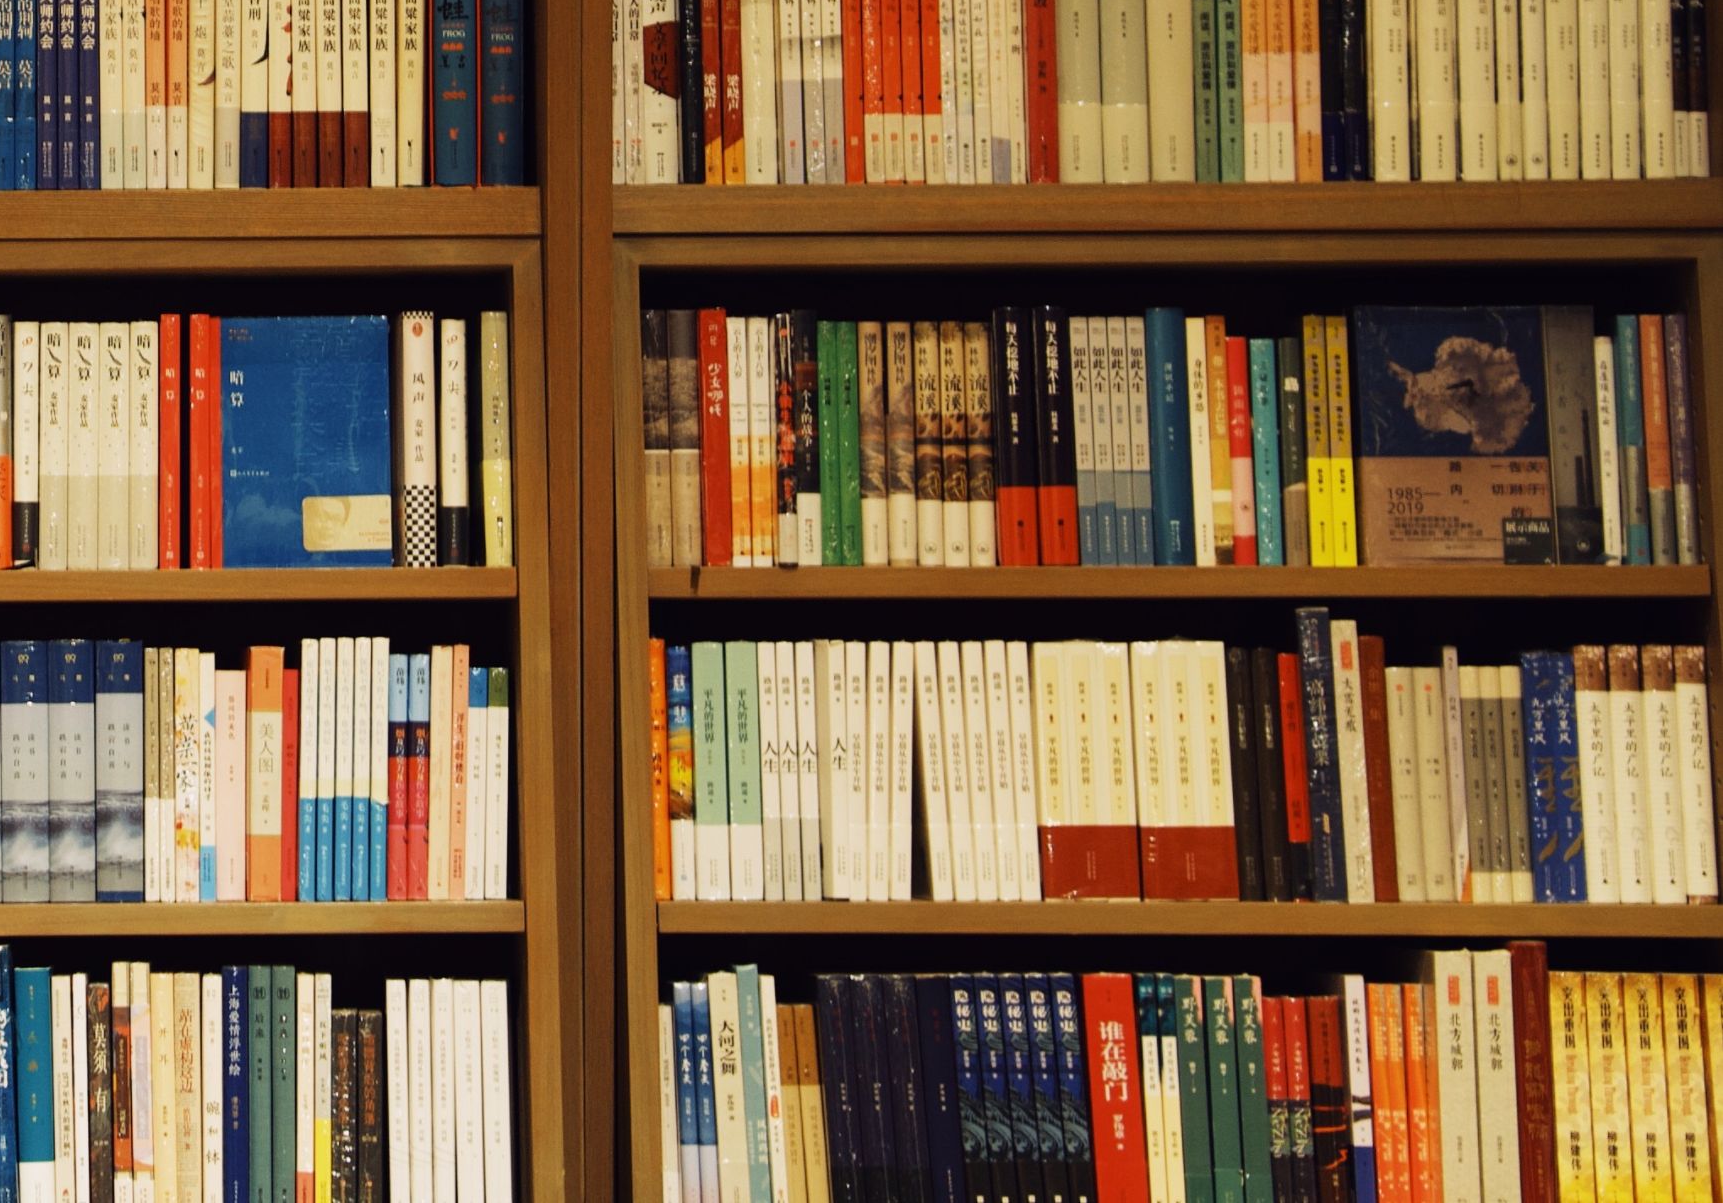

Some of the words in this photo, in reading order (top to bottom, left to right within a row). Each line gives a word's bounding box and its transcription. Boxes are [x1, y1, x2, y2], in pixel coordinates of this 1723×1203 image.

[442, 29, 466, 38] FROG
[1006, 321, 1018, 396] 每天挖地不止
[1073, 347, 1087, 395] 如此人生
[1093, 347, 1106, 395] 如此人生
[1111, 347, 1125, 395] 如此人生
[1130, 347, 1144, 395] 如此人生
[229, 370, 245, 408] 暗算
[412, 372, 425, 405] 风声
[919, 375, 937, 413] 流溪
[800, 379, 814, 449] 一个人的战争
[1387, 501, 1425, 514] 2019
[671, 673, 687, 725] 慈悲
[703, 689, 716, 744] 平凡的世界
[258, 721, 274, 775] 美人图
[763, 739, 778, 774] 人生
[781, 739, 796, 774] 人生
[800, 739, 816, 774] 人生
[831, 736, 847, 772] 人生
[228, 983, 241, 1077] 上海爱情浮世绘
[954, 988, 971, 1032] 隐秘史
[1181, 996, 1198, 1044] 野芙蓉
[1562, 987, 1575, 1049] 突出重围
[179, 1009, 196, 1094] 站在虚构这边
[1099, 1020, 1129, 1102] 谁在敲门
[1449, 1012, 1464, 1072] 北方城郭
[92, 1022, 108, 1114] 莫须有
[1570, 1131, 1581, 1171] 柳建伟
